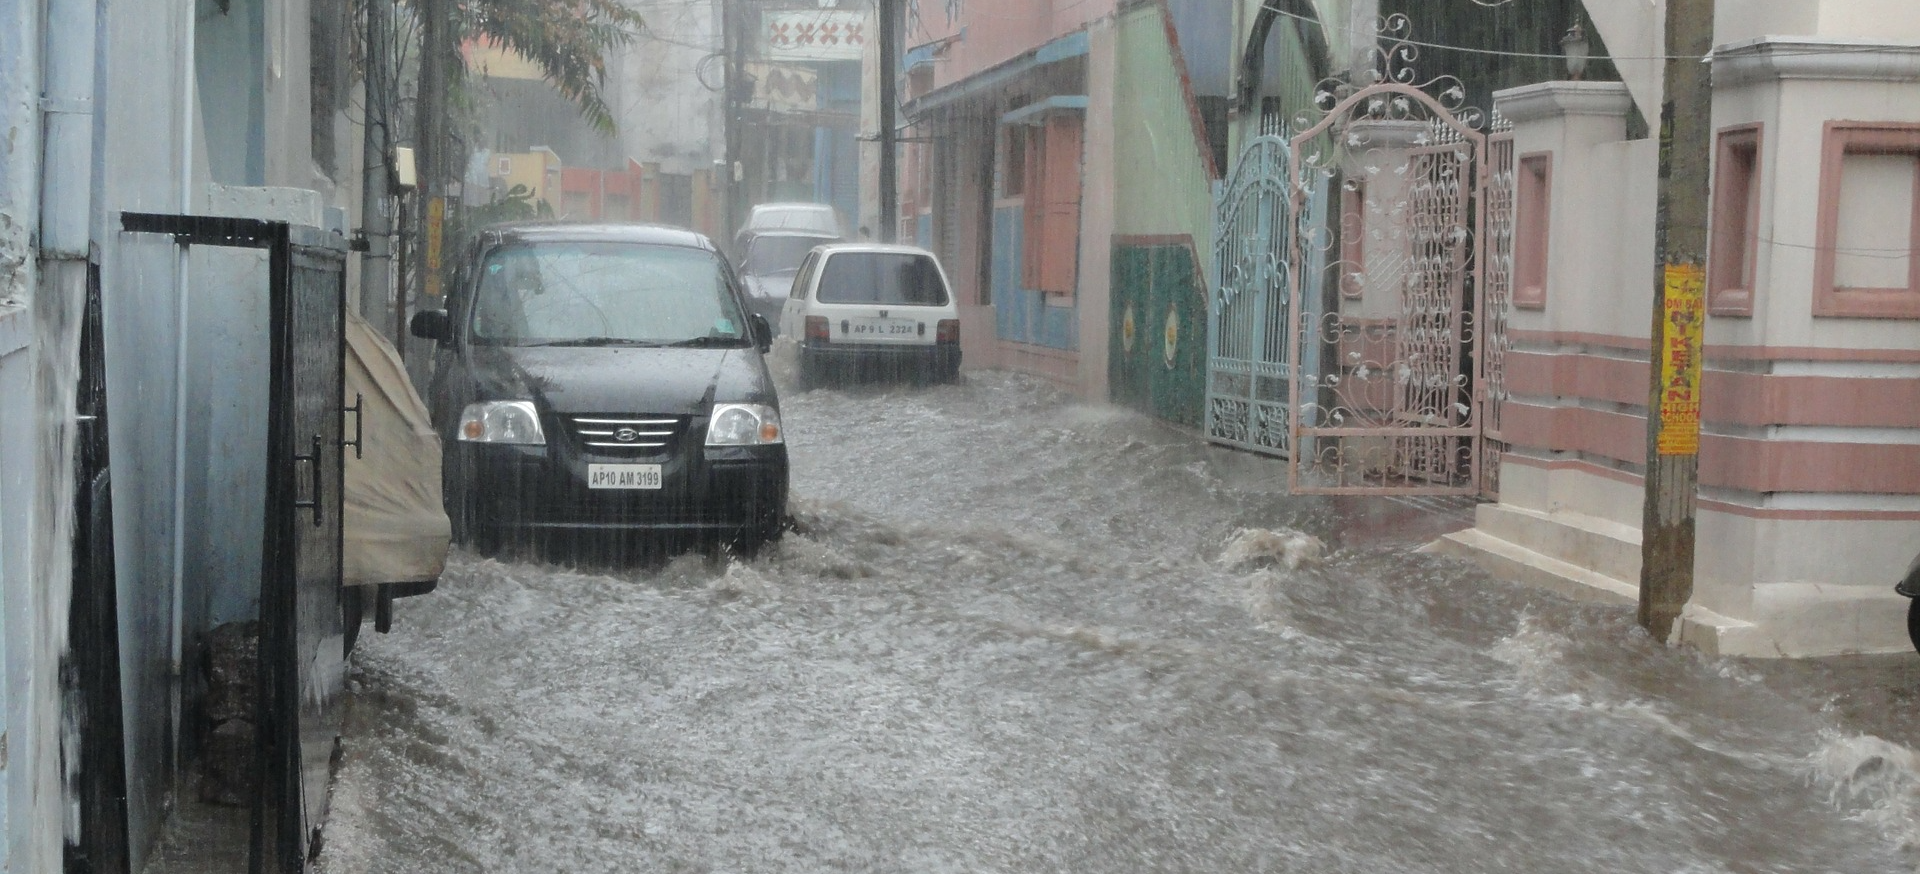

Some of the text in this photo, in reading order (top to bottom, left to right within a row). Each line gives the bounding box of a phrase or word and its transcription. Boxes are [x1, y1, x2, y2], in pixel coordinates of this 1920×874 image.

[1666, 299, 1703, 309] OM SAI
[854, 325, 867, 334] AP
[869, 325, 875, 334] 9
[878, 325, 884, 334] L
[1668, 311, 1694, 402] NIKETAN
[1662, 403, 1699, 412] HIGH
[592, 471, 659, 486] AP10 AM 3199
